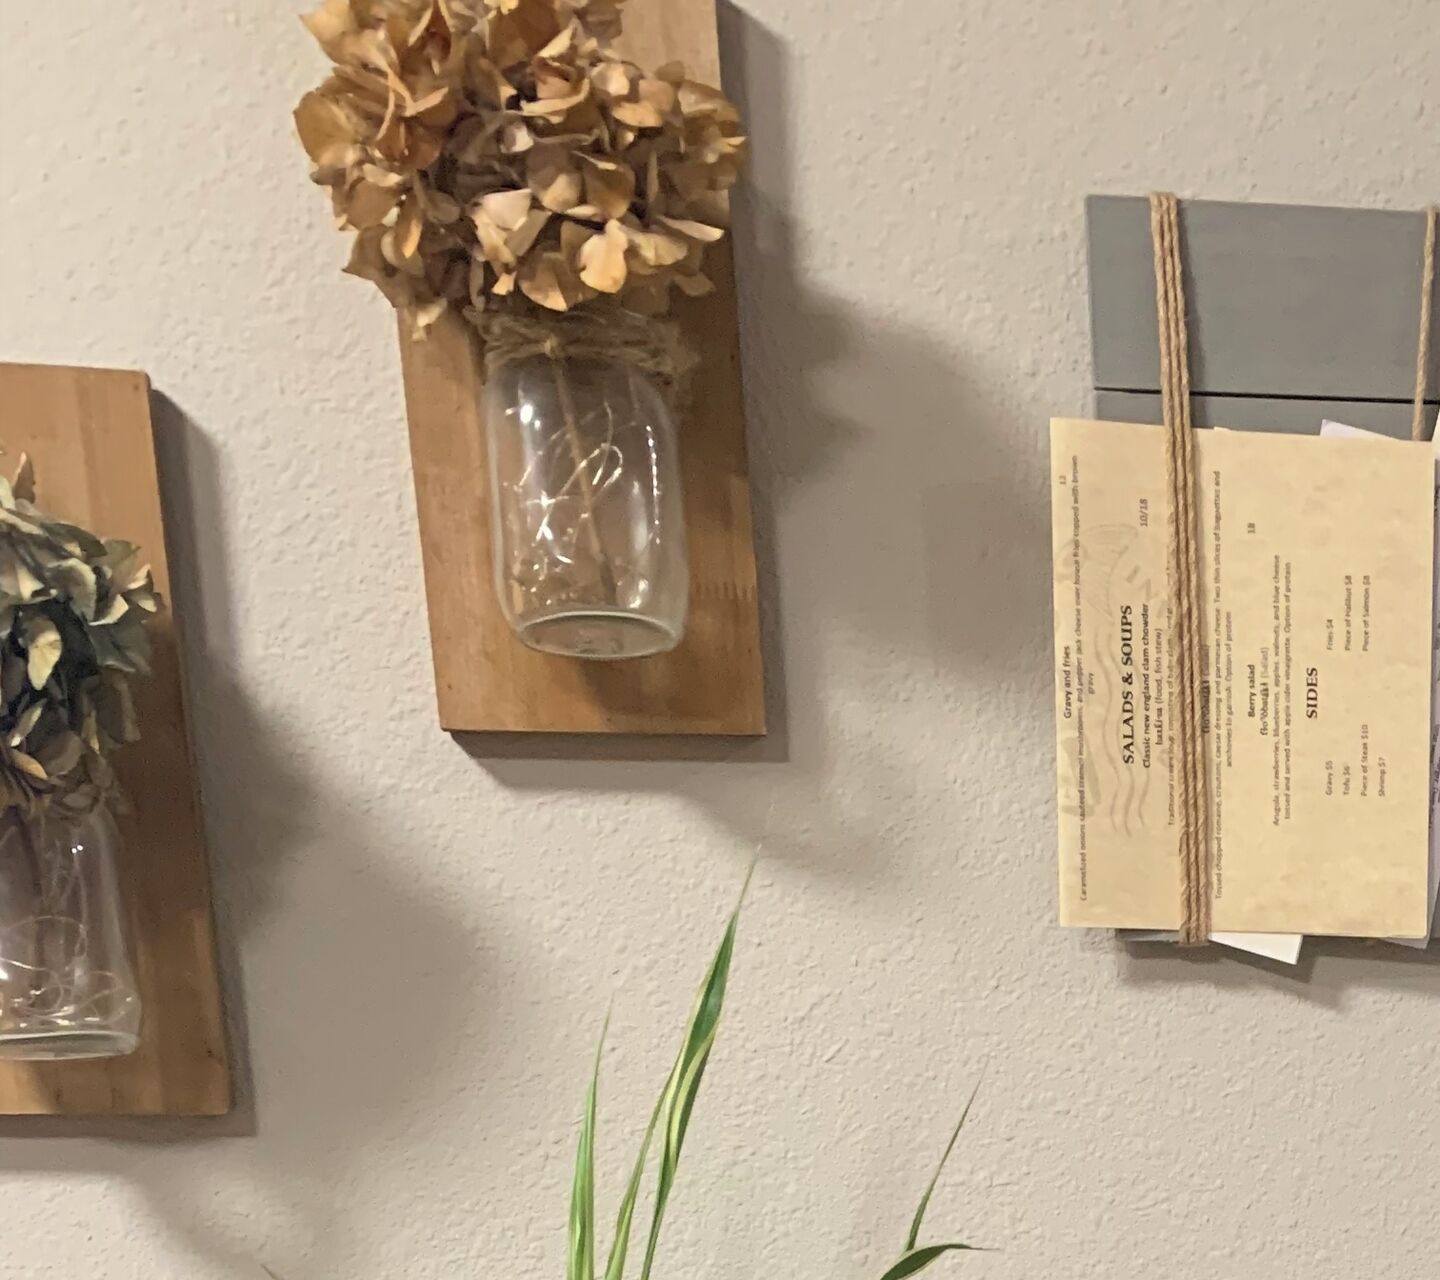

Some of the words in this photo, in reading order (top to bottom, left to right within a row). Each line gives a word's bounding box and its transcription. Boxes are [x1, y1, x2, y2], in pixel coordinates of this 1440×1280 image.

[1361, 587, 1370, 617] Salmon
[1139, 603, 1150, 646] chowder
[1343, 618, 1352, 628] of
[1361, 618, 1370, 628] of
[1120, 604, 1135, 667] SOUPS
[1153, 627, 1164, 655] stew)
[1343, 629, 1352, 651] Piece
[1361, 629, 1370, 652] Piece
[1060, 646, 1071, 667] fries
[1140, 647, 1150, 672] clam
[1153, 656, 1163, 675] fish
[1061, 670, 1072, 689] and
[1120, 671, 1134, 686] &
[1246, 664, 1256, 690] salad
[1063, 690, 1076, 719] Gravy
[1141, 674, 1153, 712] england
[1246, 691, 1258, 718] Berry
[1305, 666, 1319, 719] SIDES
[1121, 690, 1136, 765] SALADS
[1142, 714, 1151, 735] new
[1142, 737, 1152, 769] Classic
[1360, 741, 1369, 763] Steak
[1360, 764, 1369, 774] of
[1325, 772, 1335, 796] Gravy
[1342, 778, 1352, 796] Tofu
[1360, 775, 1369, 797] Piece
[1377, 769, 1387, 797] Shrimp
